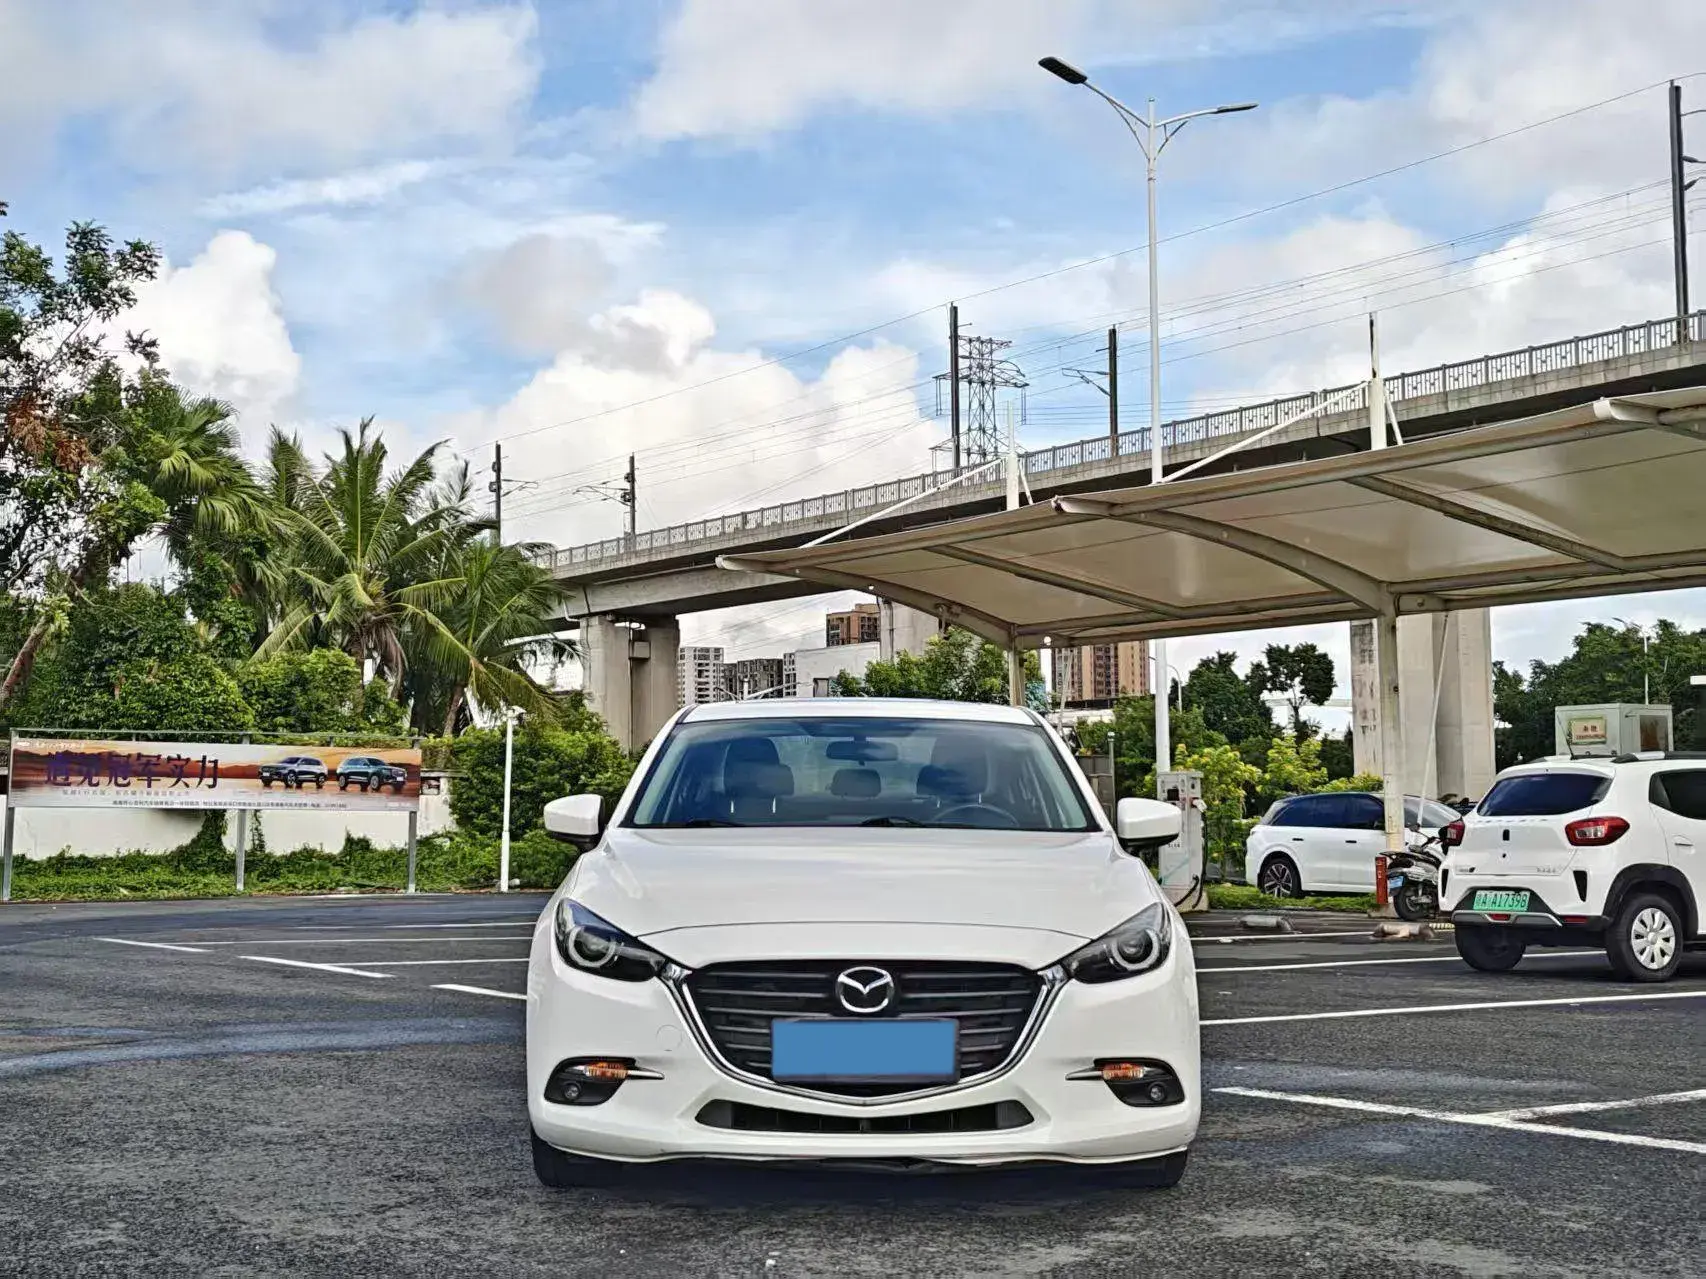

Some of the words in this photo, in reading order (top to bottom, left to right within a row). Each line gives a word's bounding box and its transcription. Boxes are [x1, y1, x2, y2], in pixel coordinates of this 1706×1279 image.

[45, 752, 219, 788] 遇见冠军实力
